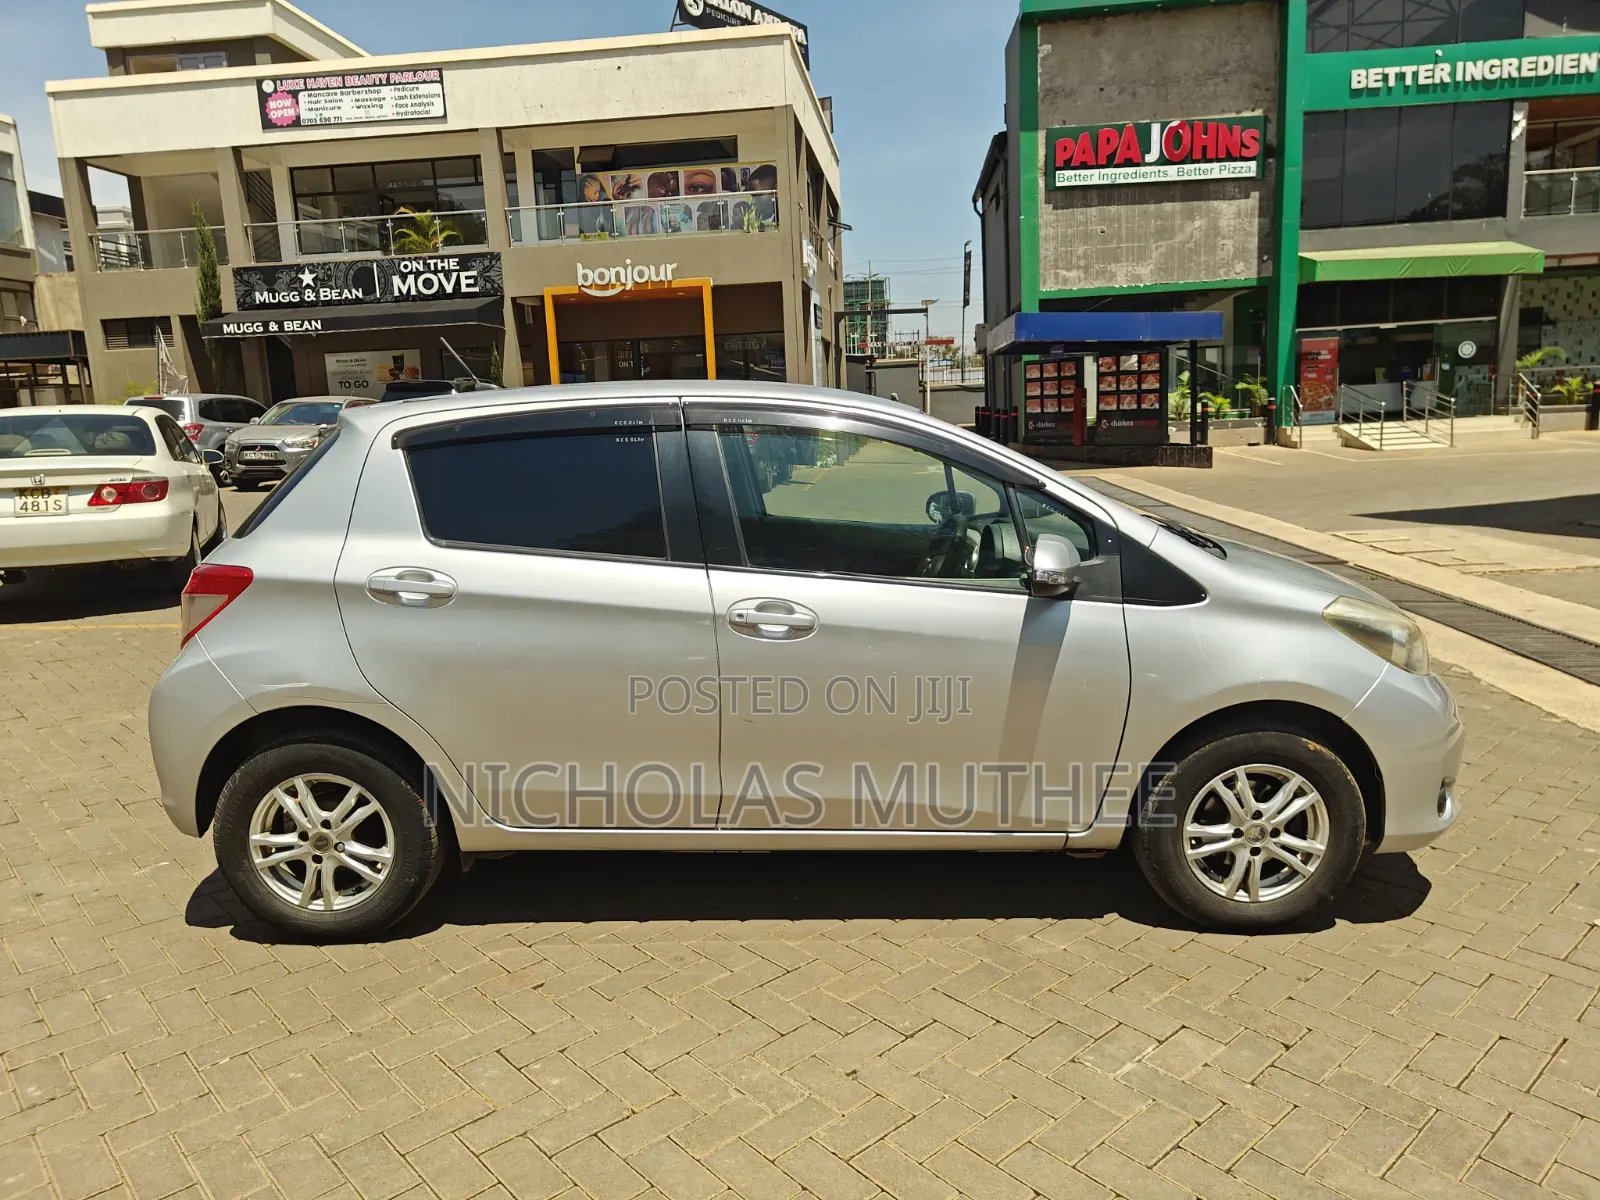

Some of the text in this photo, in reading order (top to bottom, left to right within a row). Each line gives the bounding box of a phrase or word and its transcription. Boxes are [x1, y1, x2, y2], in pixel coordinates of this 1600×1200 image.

[706, 7, 741, 26] PEDICURE
[1350, 52, 1600, 90] BETTER INGREDIEN
[277, 70, 440, 90] LUXE HAVEN BEAUTY PARLOUR
[308, 88, 382, 98] Mancave Barbershop
[270, 99, 292, 110] NOW
[410, 100, 434, 108] Analysis
[270, 108, 296, 118] OPEN
[1055, 120, 1260, 168] PAPA JOHNS
[1057, 164, 1255, 184] Better Ingredients. Better Pizza.
[400, 258, 460, 273] ON THE
[576, 259, 678, 290] bonjour
[392, 270, 480, 297] MOVE
[304, 289, 316, 302] &
[222, 320, 322, 334] MUGG & BEAN
[338, 380, 369, 389] TO GO
[1036, 420, 1055, 428] chicken
[1111, 419, 1133, 427] chicken
[20, 488, 51, 500] KCB
[20, 500, 62, 512] 481S
